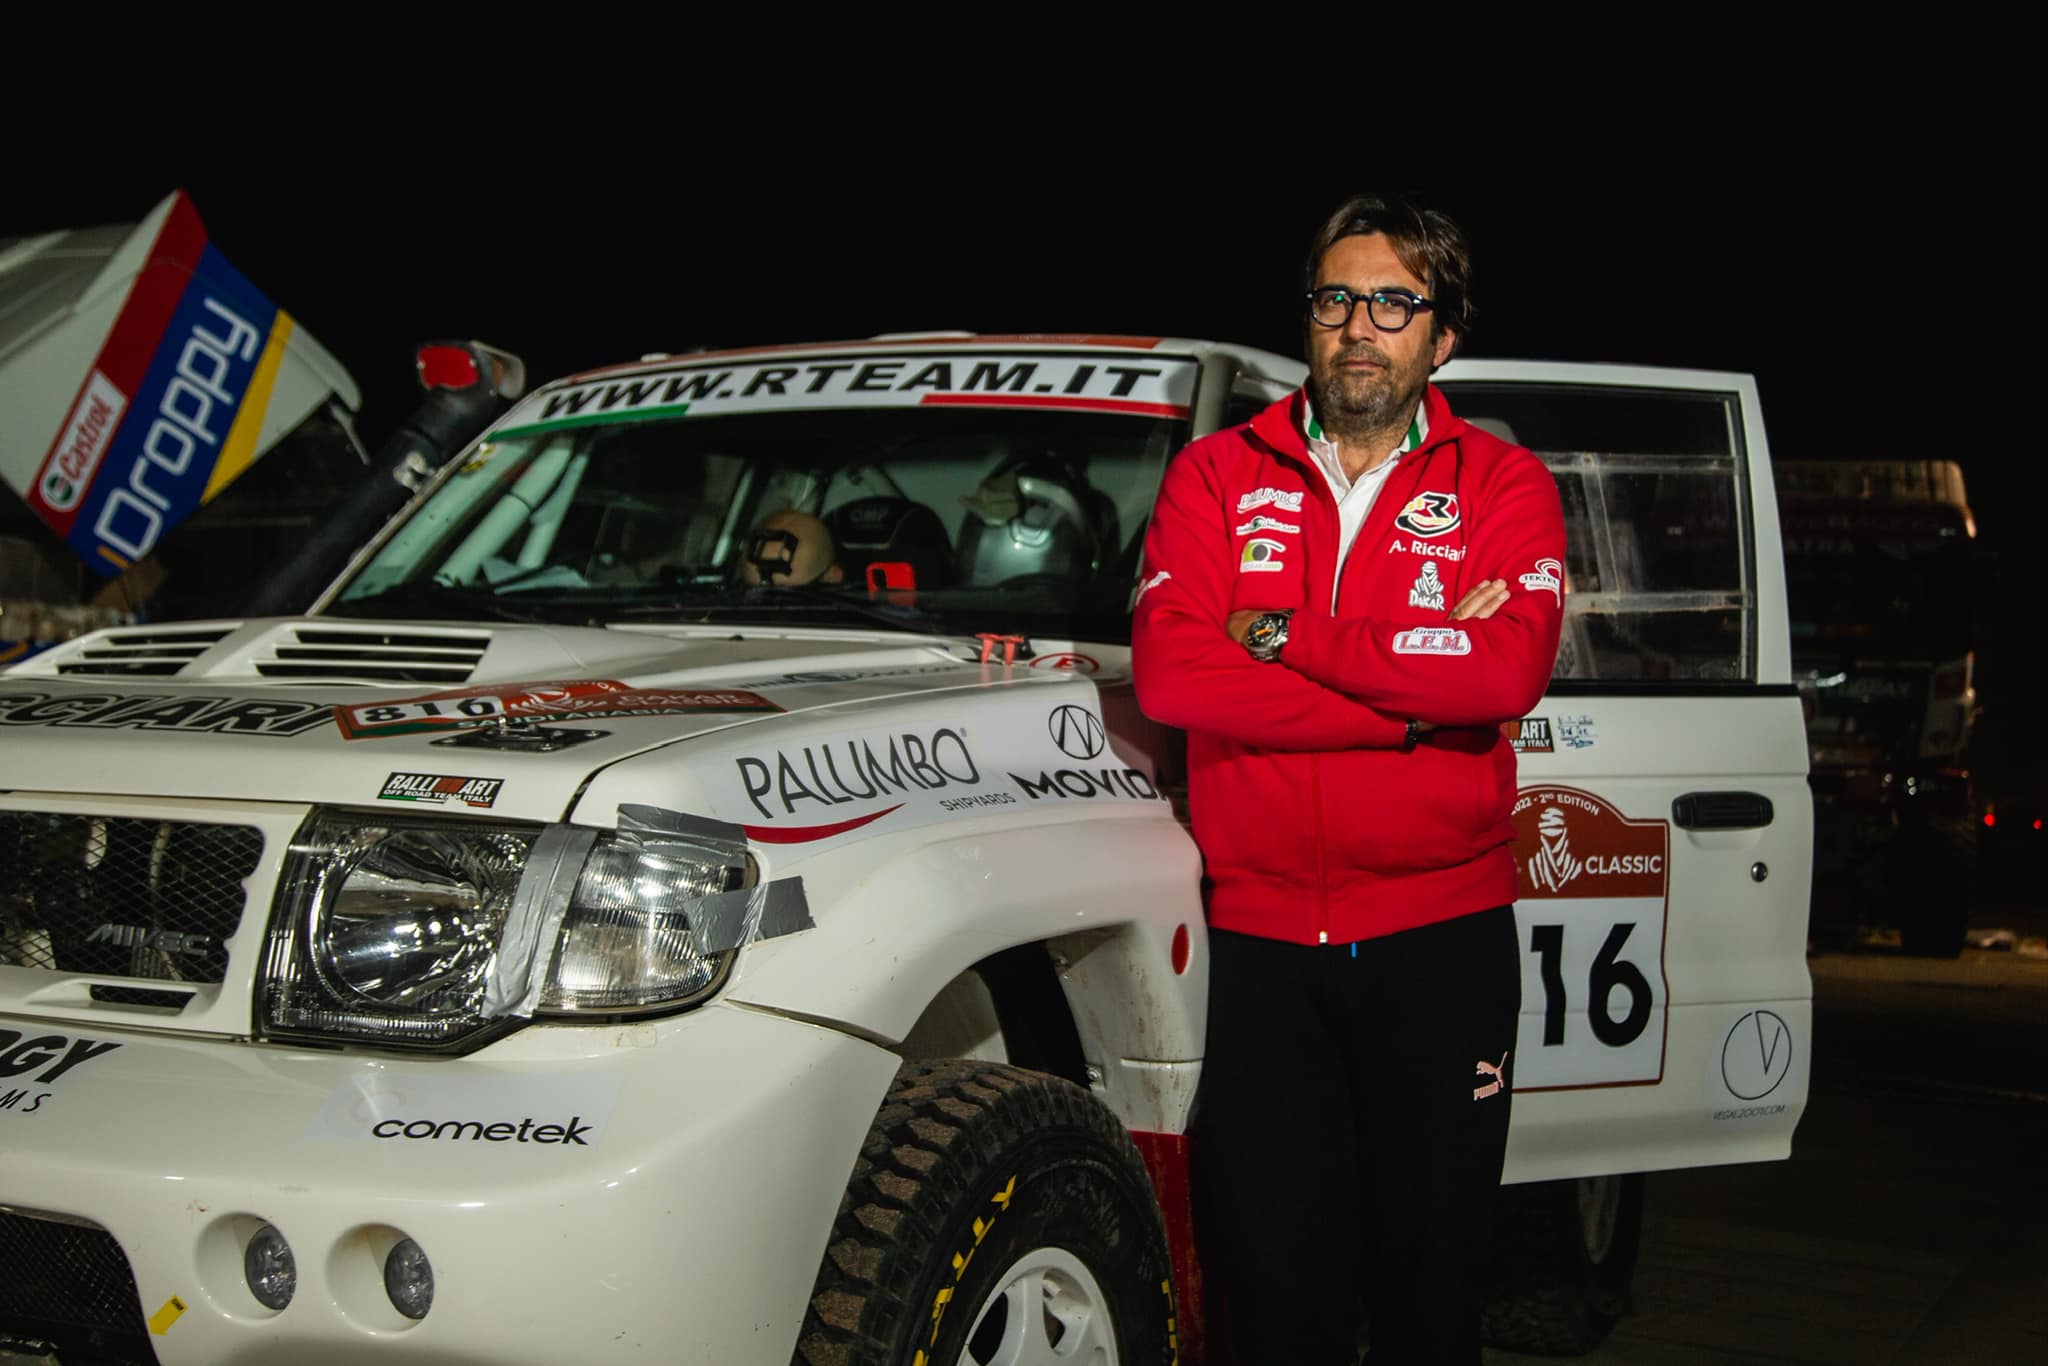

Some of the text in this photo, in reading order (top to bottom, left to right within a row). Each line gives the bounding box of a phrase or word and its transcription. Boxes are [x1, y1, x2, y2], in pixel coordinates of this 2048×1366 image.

[538, 361, 1163, 420] WWW.RTEAM.IT
[60, 393, 113, 480] Castrol
[94, 296, 260, 561] Droppy
[1388, 539, 1407, 554] A.
[1409, 588, 1445, 612] DAKAR
[364, 697, 496, 722] 816
[1520, 720, 1547, 739] ART
[736, 728, 980, 819] PALUMBO
[939, 792, 1017, 812] SHIPYARDS
[1557, 794, 1600, 816] EDITION
[1585, 855, 1662, 874] CLASSIC
[1530, 922, 1652, 1048] 16
[372, 1116, 593, 1146] cometek
